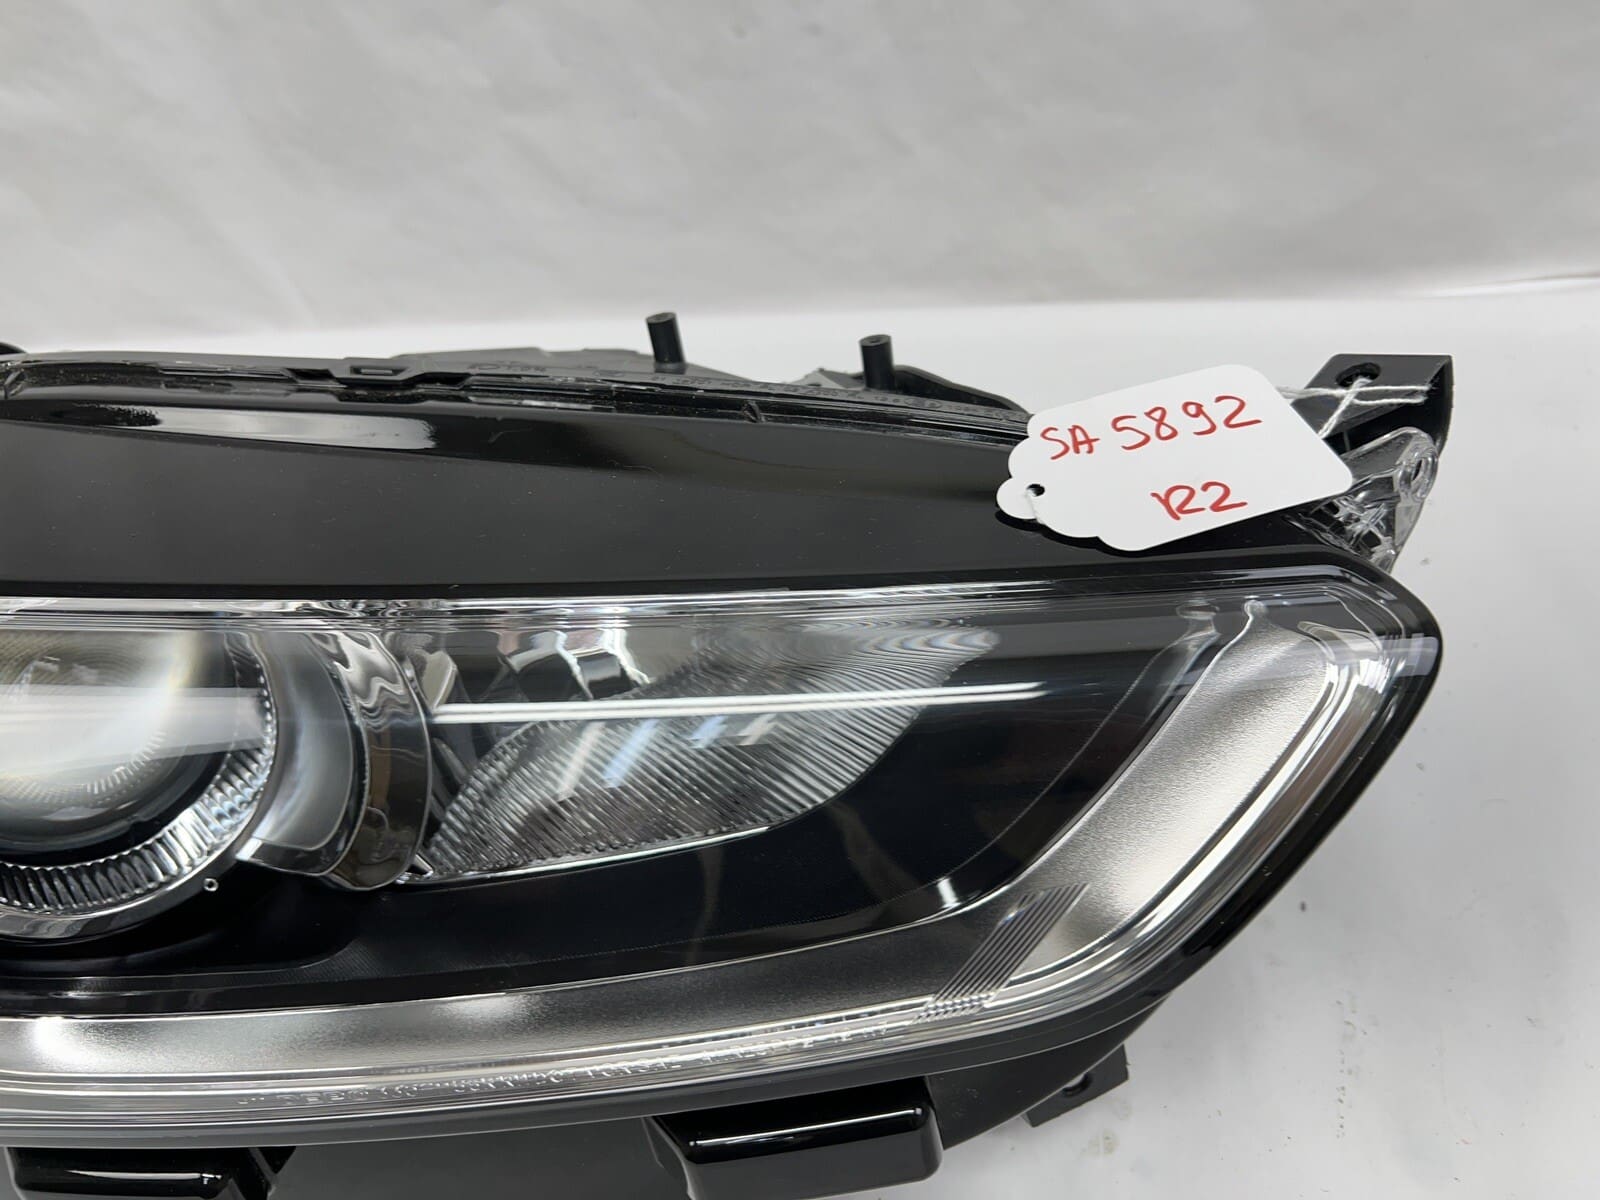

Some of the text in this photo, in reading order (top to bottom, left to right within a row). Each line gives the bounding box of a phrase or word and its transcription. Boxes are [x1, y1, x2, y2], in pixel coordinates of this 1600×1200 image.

[1040, 395, 1262, 460] SA 5892
[1150, 481, 1248, 521] R2
